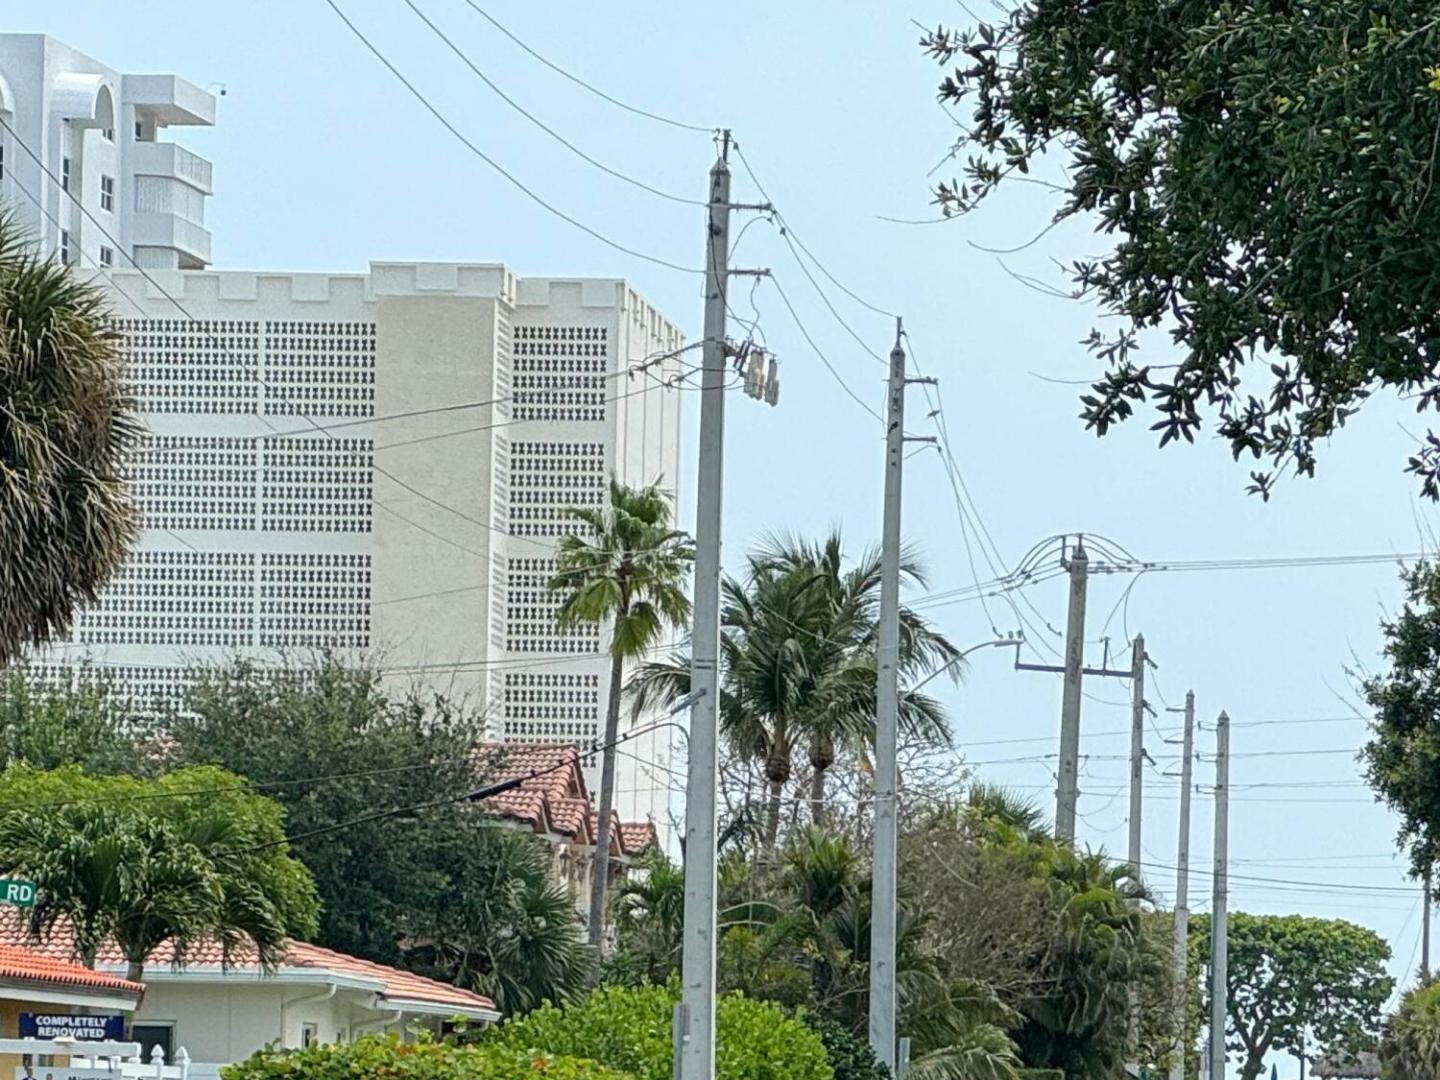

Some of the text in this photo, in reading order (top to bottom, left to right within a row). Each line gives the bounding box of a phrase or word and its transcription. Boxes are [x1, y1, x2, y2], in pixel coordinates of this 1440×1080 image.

[7, 884, 32, 901] RD
[36, 1016, 107, 1027] COMPLETELY
[38, 1027, 104, 1038] RENOVATED
